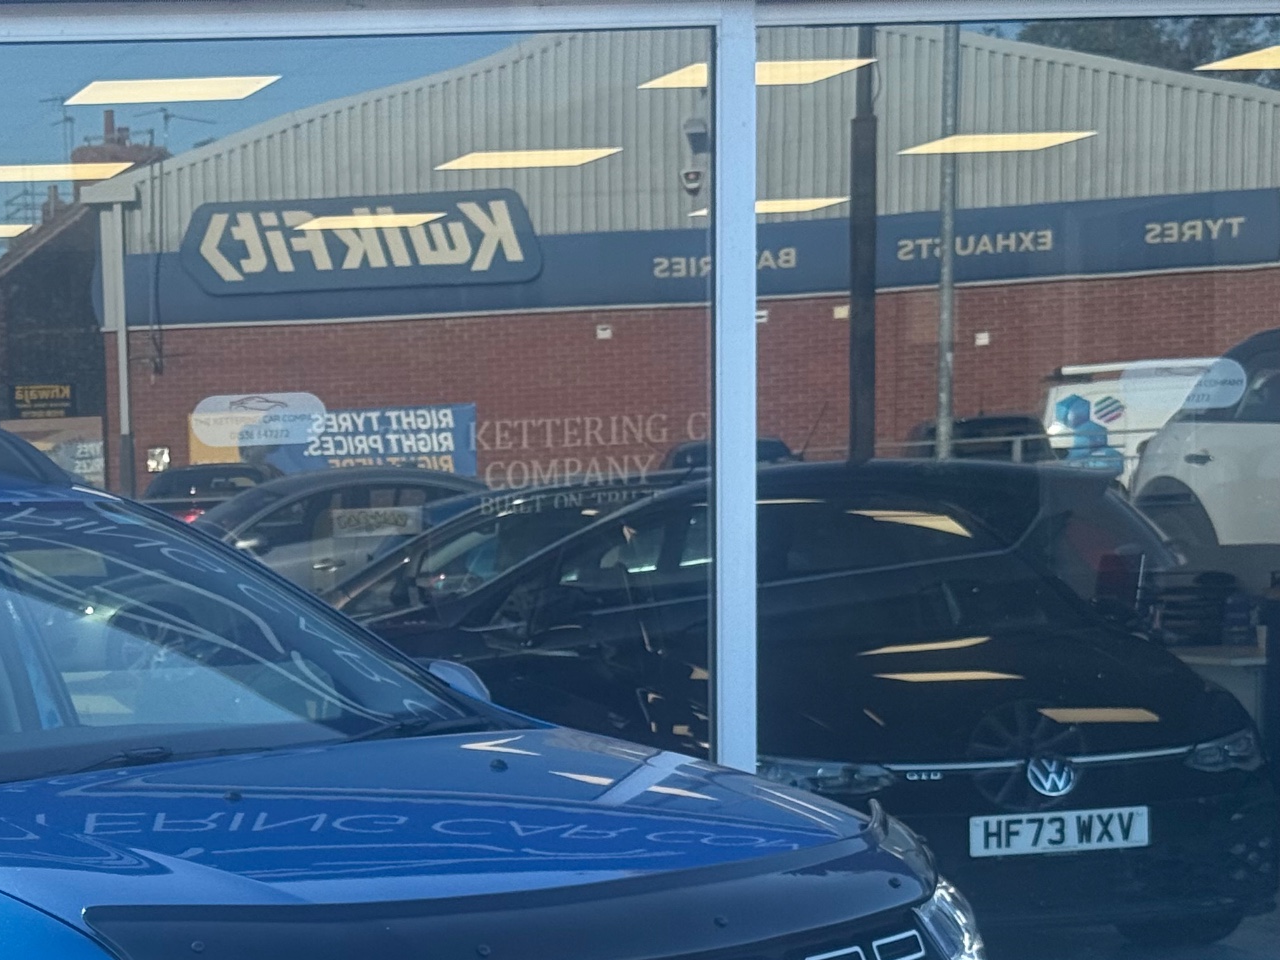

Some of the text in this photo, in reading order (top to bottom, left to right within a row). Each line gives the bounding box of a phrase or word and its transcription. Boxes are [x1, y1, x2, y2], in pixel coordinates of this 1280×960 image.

[471, 413, 669, 450] KETTERING
[485, 455, 656, 490] COMPANY
[983, 811, 1135, 850] HF73 WXV
